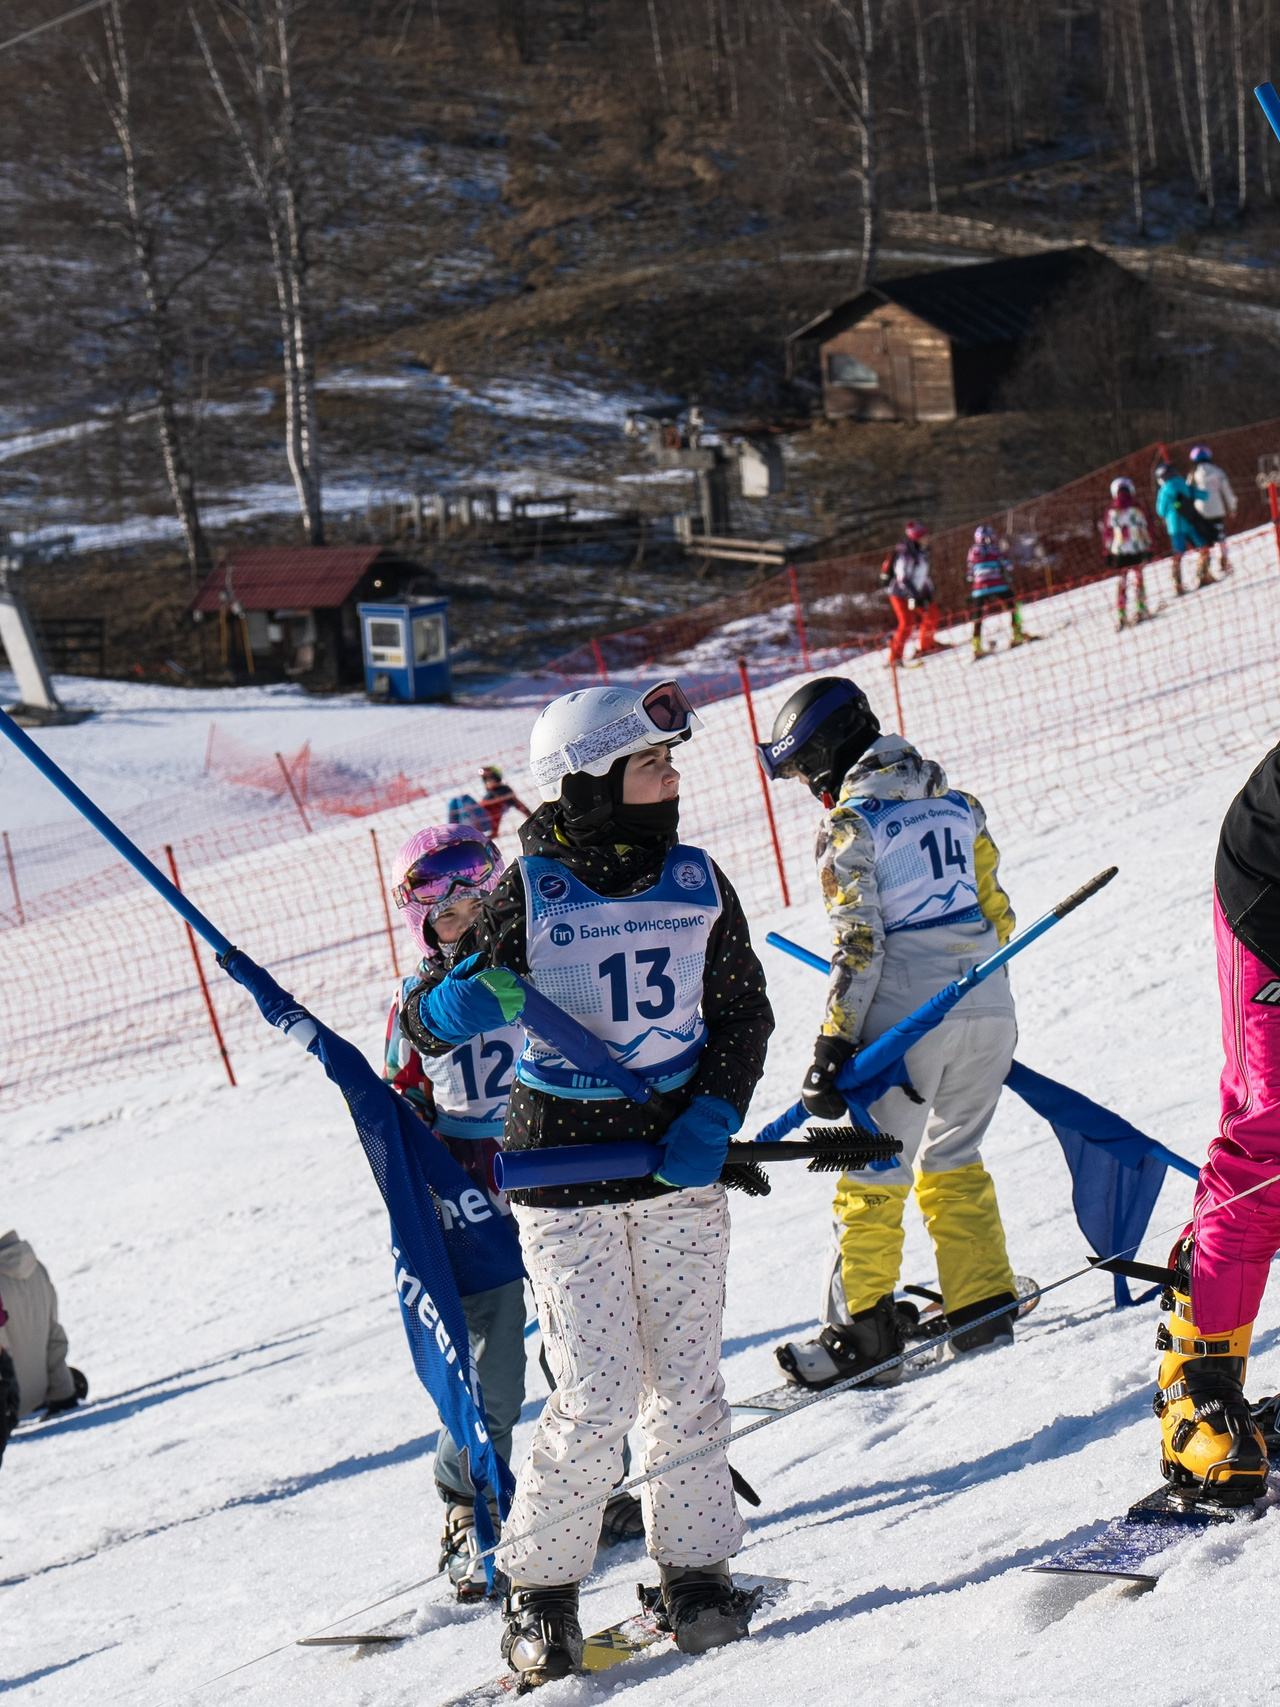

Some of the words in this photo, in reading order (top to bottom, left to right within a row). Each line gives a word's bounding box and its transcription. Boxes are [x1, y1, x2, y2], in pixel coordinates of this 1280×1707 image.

[771, 735, 795, 758] POC
[903, 813, 928, 827] Банк
[919, 827, 967, 880] 14
[580, 924, 620, 939] Банк
[624, 914, 704, 934] Финсервис
[598, 947, 676, 1022] 13
[452, 1040, 514, 1100] 12
